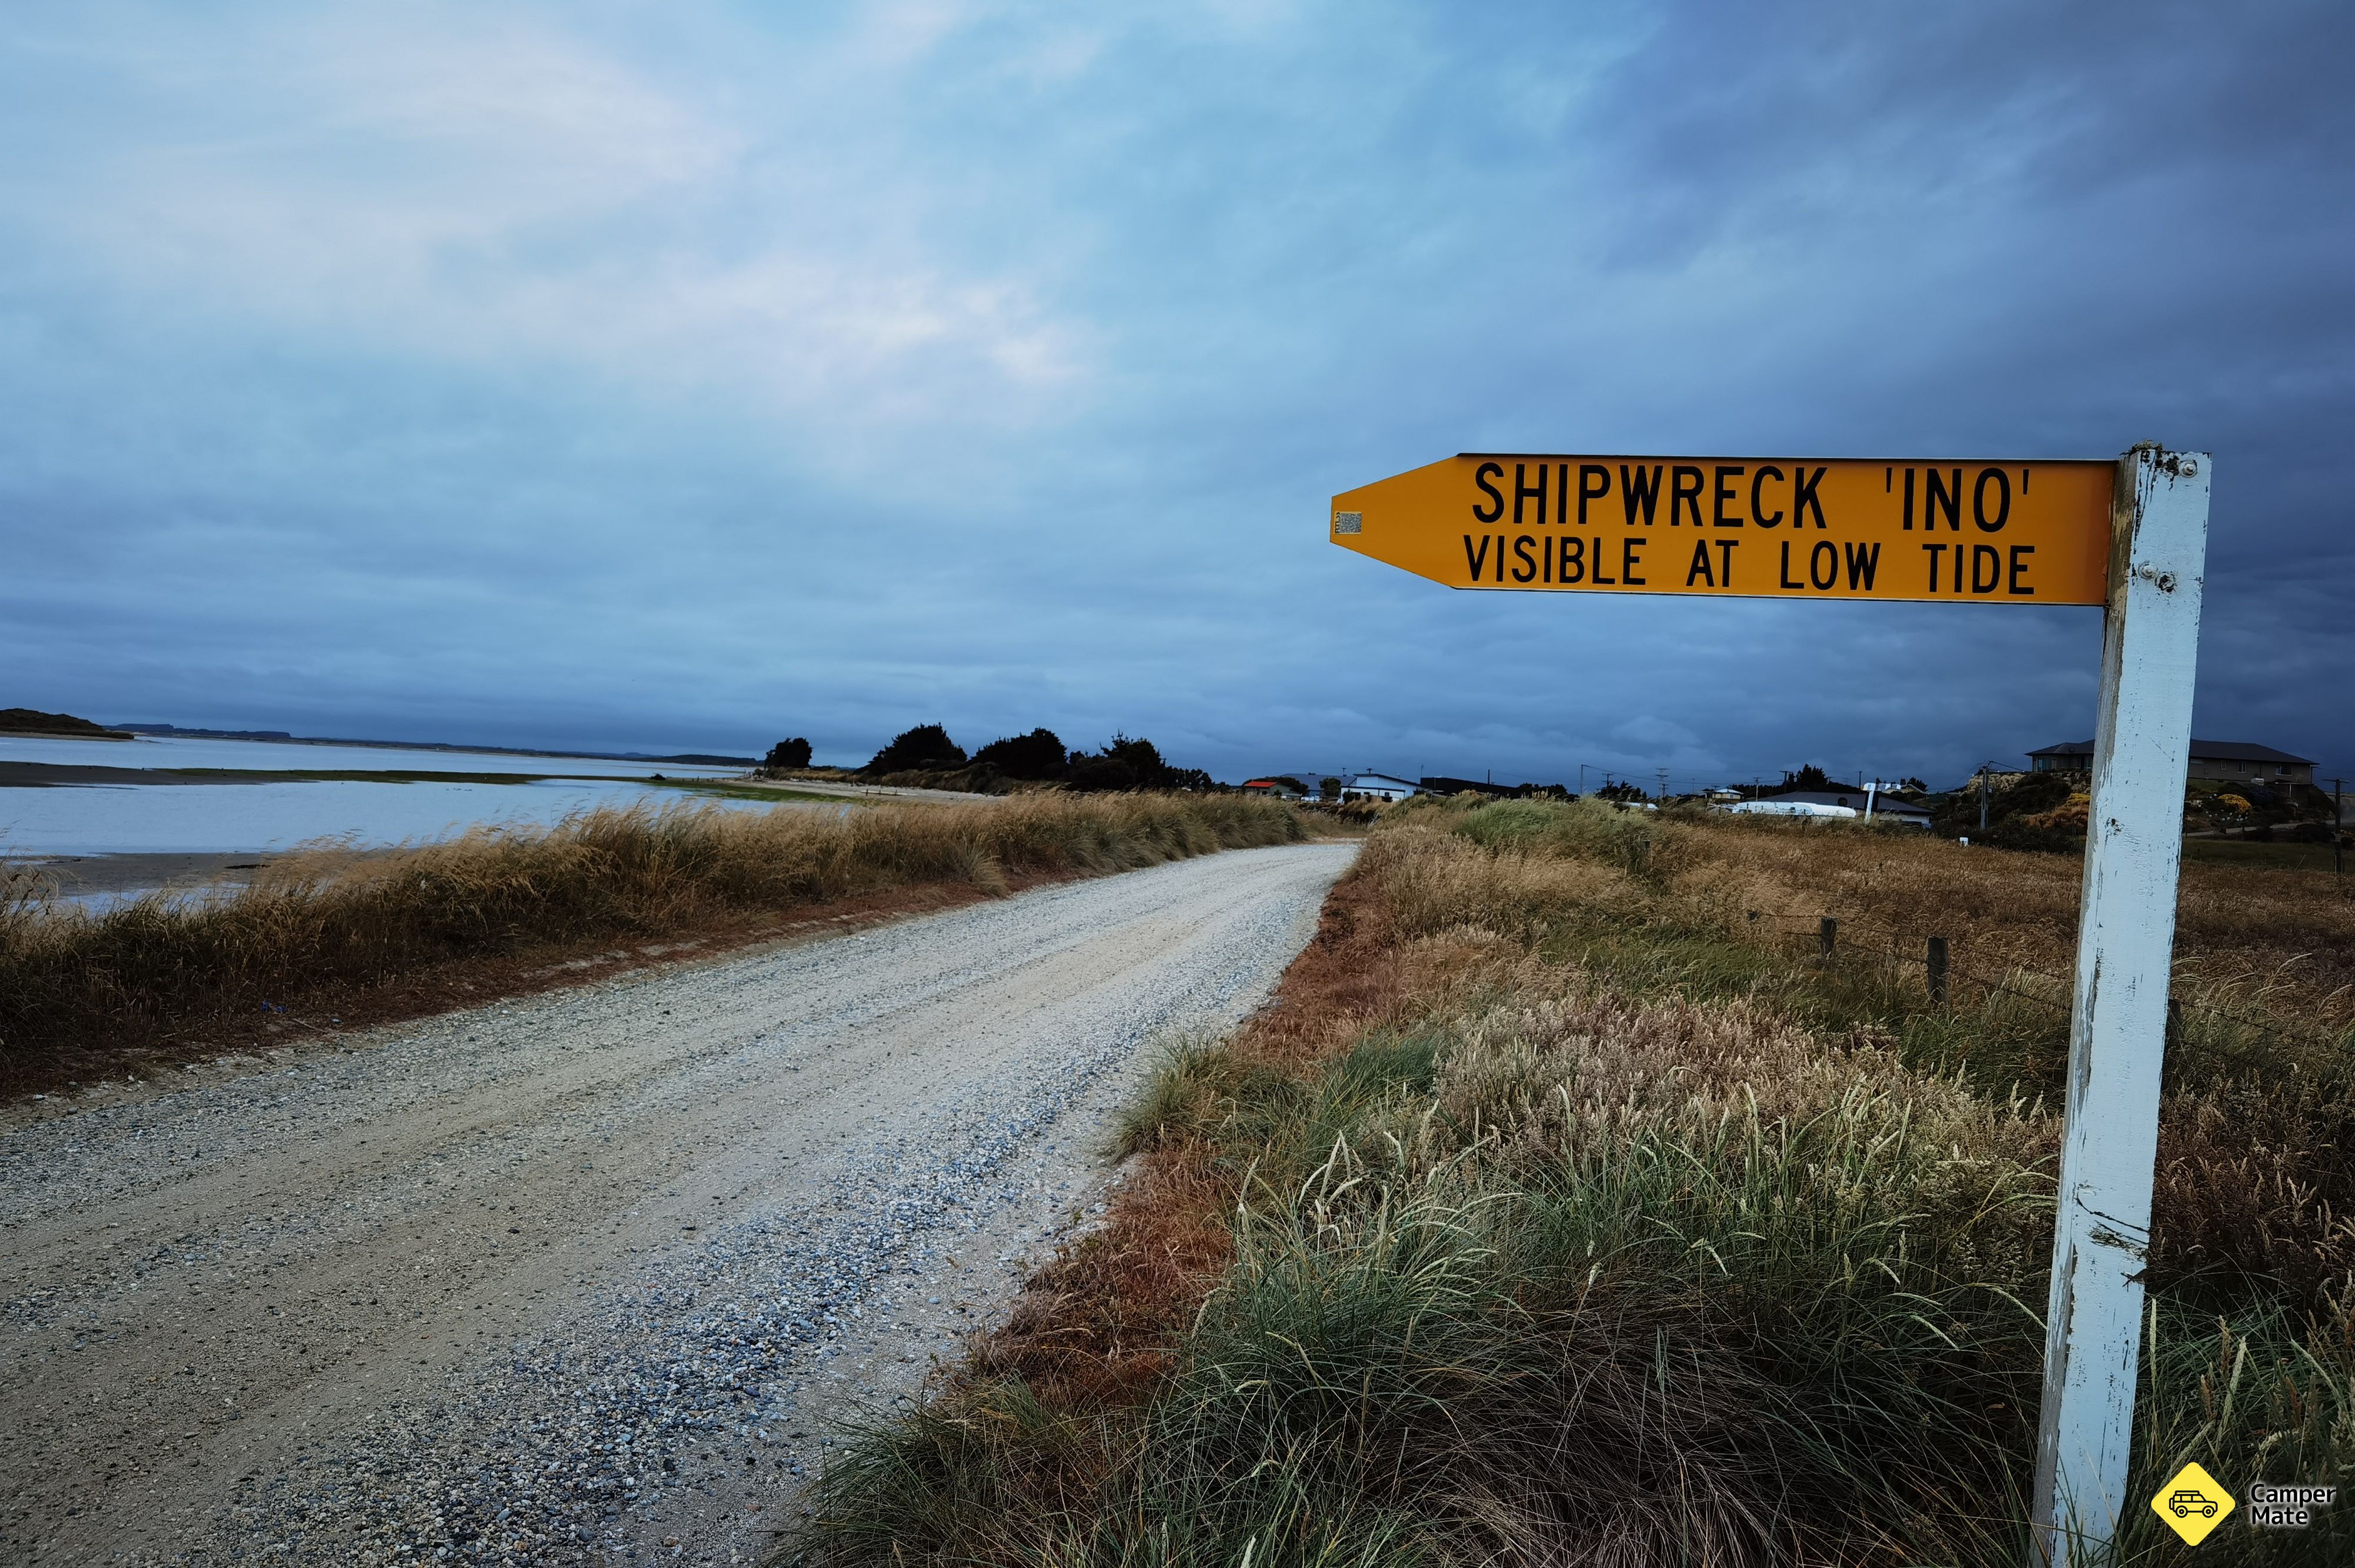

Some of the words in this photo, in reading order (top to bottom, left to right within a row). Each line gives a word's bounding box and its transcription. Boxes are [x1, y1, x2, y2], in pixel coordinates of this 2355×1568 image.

[1472, 462, 1828, 529] SHIPWRECK
[1885, 467, 2030, 533] 'INO'
[1463, 534, 1647, 586] VISIBLE
[1686, 539, 1739, 587] AT
[1780, 540, 1881, 591] LOW
[1922, 543, 2035, 595] TIDE
